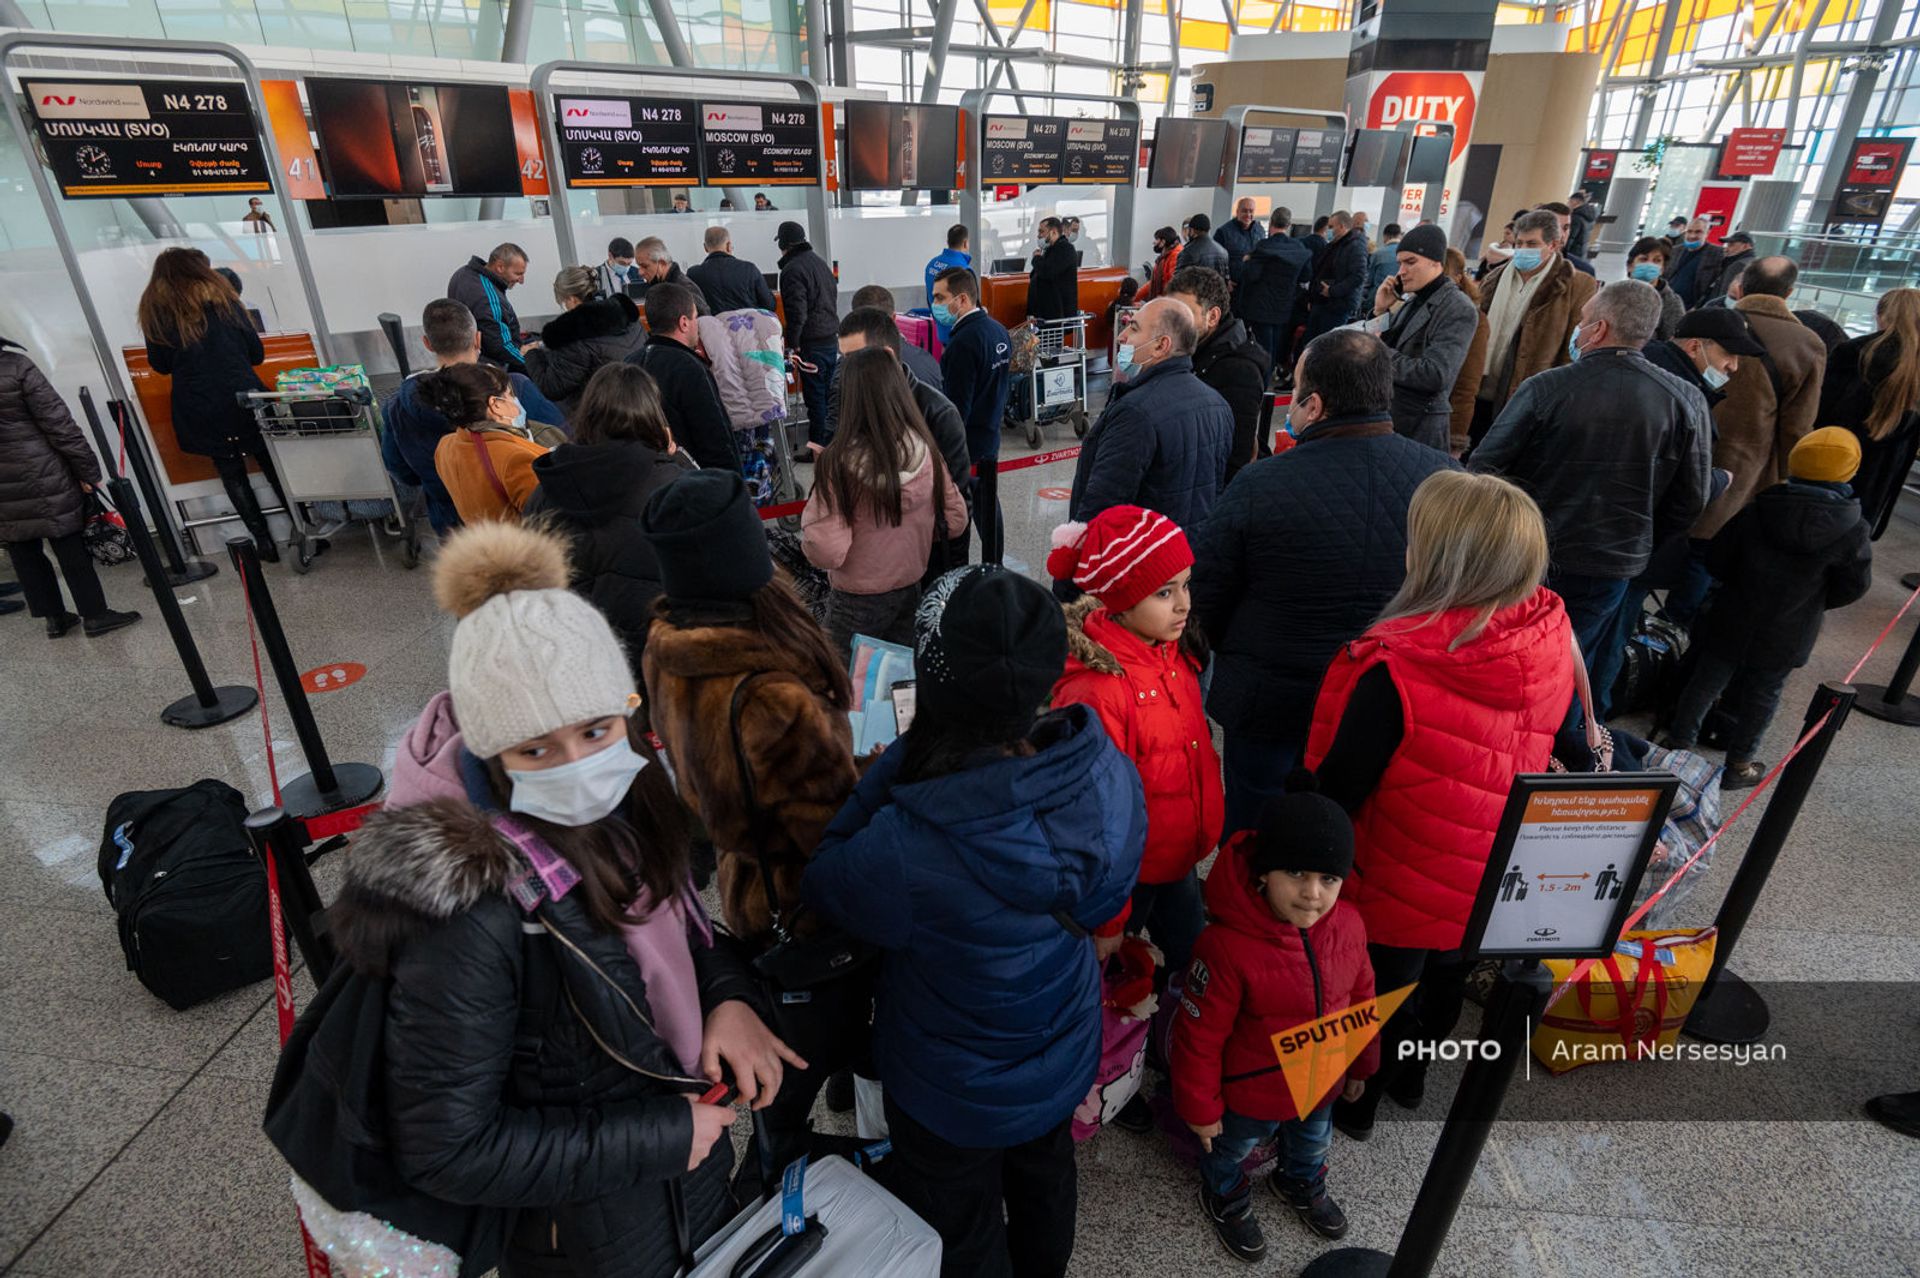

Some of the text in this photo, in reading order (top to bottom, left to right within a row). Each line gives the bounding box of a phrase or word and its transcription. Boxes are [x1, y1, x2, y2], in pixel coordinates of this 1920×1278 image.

[79, 97, 121, 106] Nordwind
[163, 94, 228, 110] N4 278
[642, 108, 682, 121] N4 278
[1381, 95, 1465, 123] DUTY
[771, 113, 786, 125] N4
[788, 113, 805, 125] 278
[44, 122, 170, 139] ՄՈՍԿՎԱ (SVO)
[1033, 124, 1057, 134] N4 278
[565, 130, 643, 143] ՄՈՍԿՎԱ (SVO)
[705, 132, 775, 145] MOSCOW (SVO)
[219, 144, 248, 152] ԿԱՐԳ
[986, 140, 1016, 149] MOSCOW
[762, 147, 792, 155] ECONOMY
[288, 158, 316, 180] 41
[522, 159, 545, 179] 42
[1563, 825, 1581, 833] keep
[1539, 883, 1555, 892] 1.5
[1562, 883, 1581, 892] 2m
